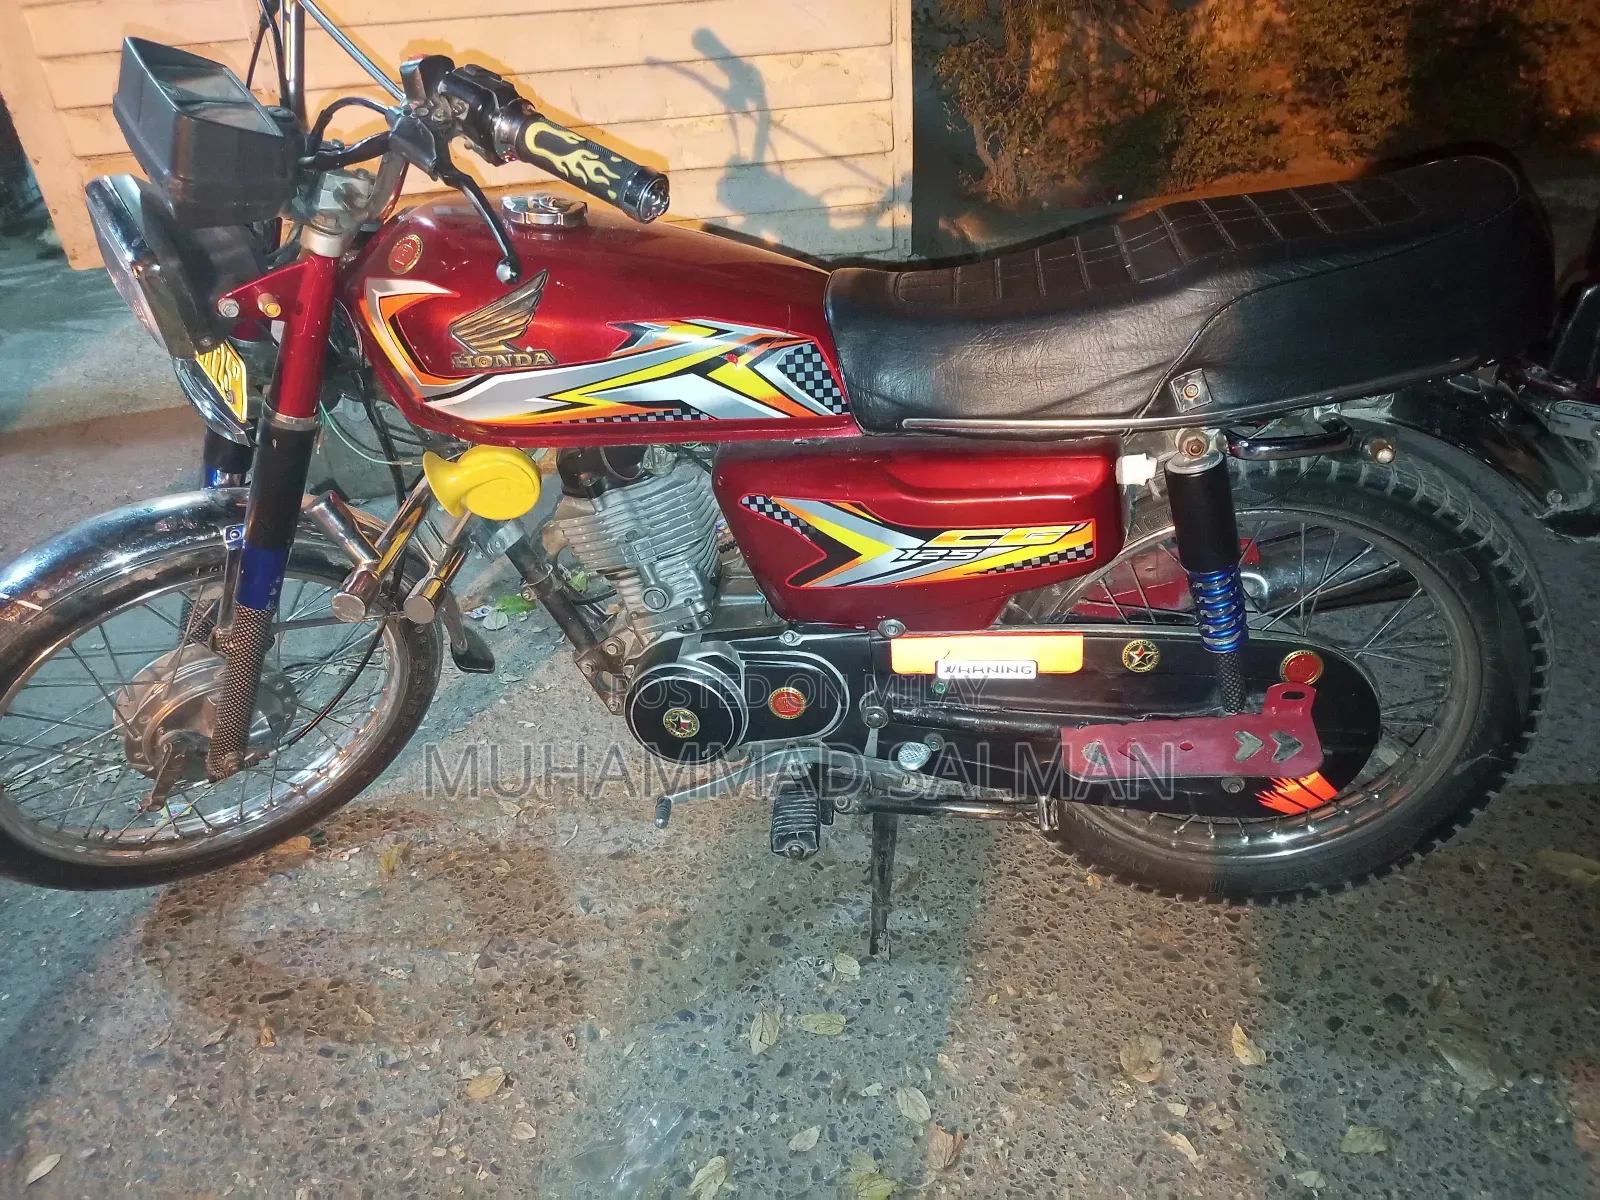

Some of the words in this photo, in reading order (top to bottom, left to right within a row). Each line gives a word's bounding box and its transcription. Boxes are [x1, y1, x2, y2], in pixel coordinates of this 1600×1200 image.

[453, 352, 552, 369] HONDA
[923, 524, 1080, 548] CG
[893, 548, 984, 563] 125
